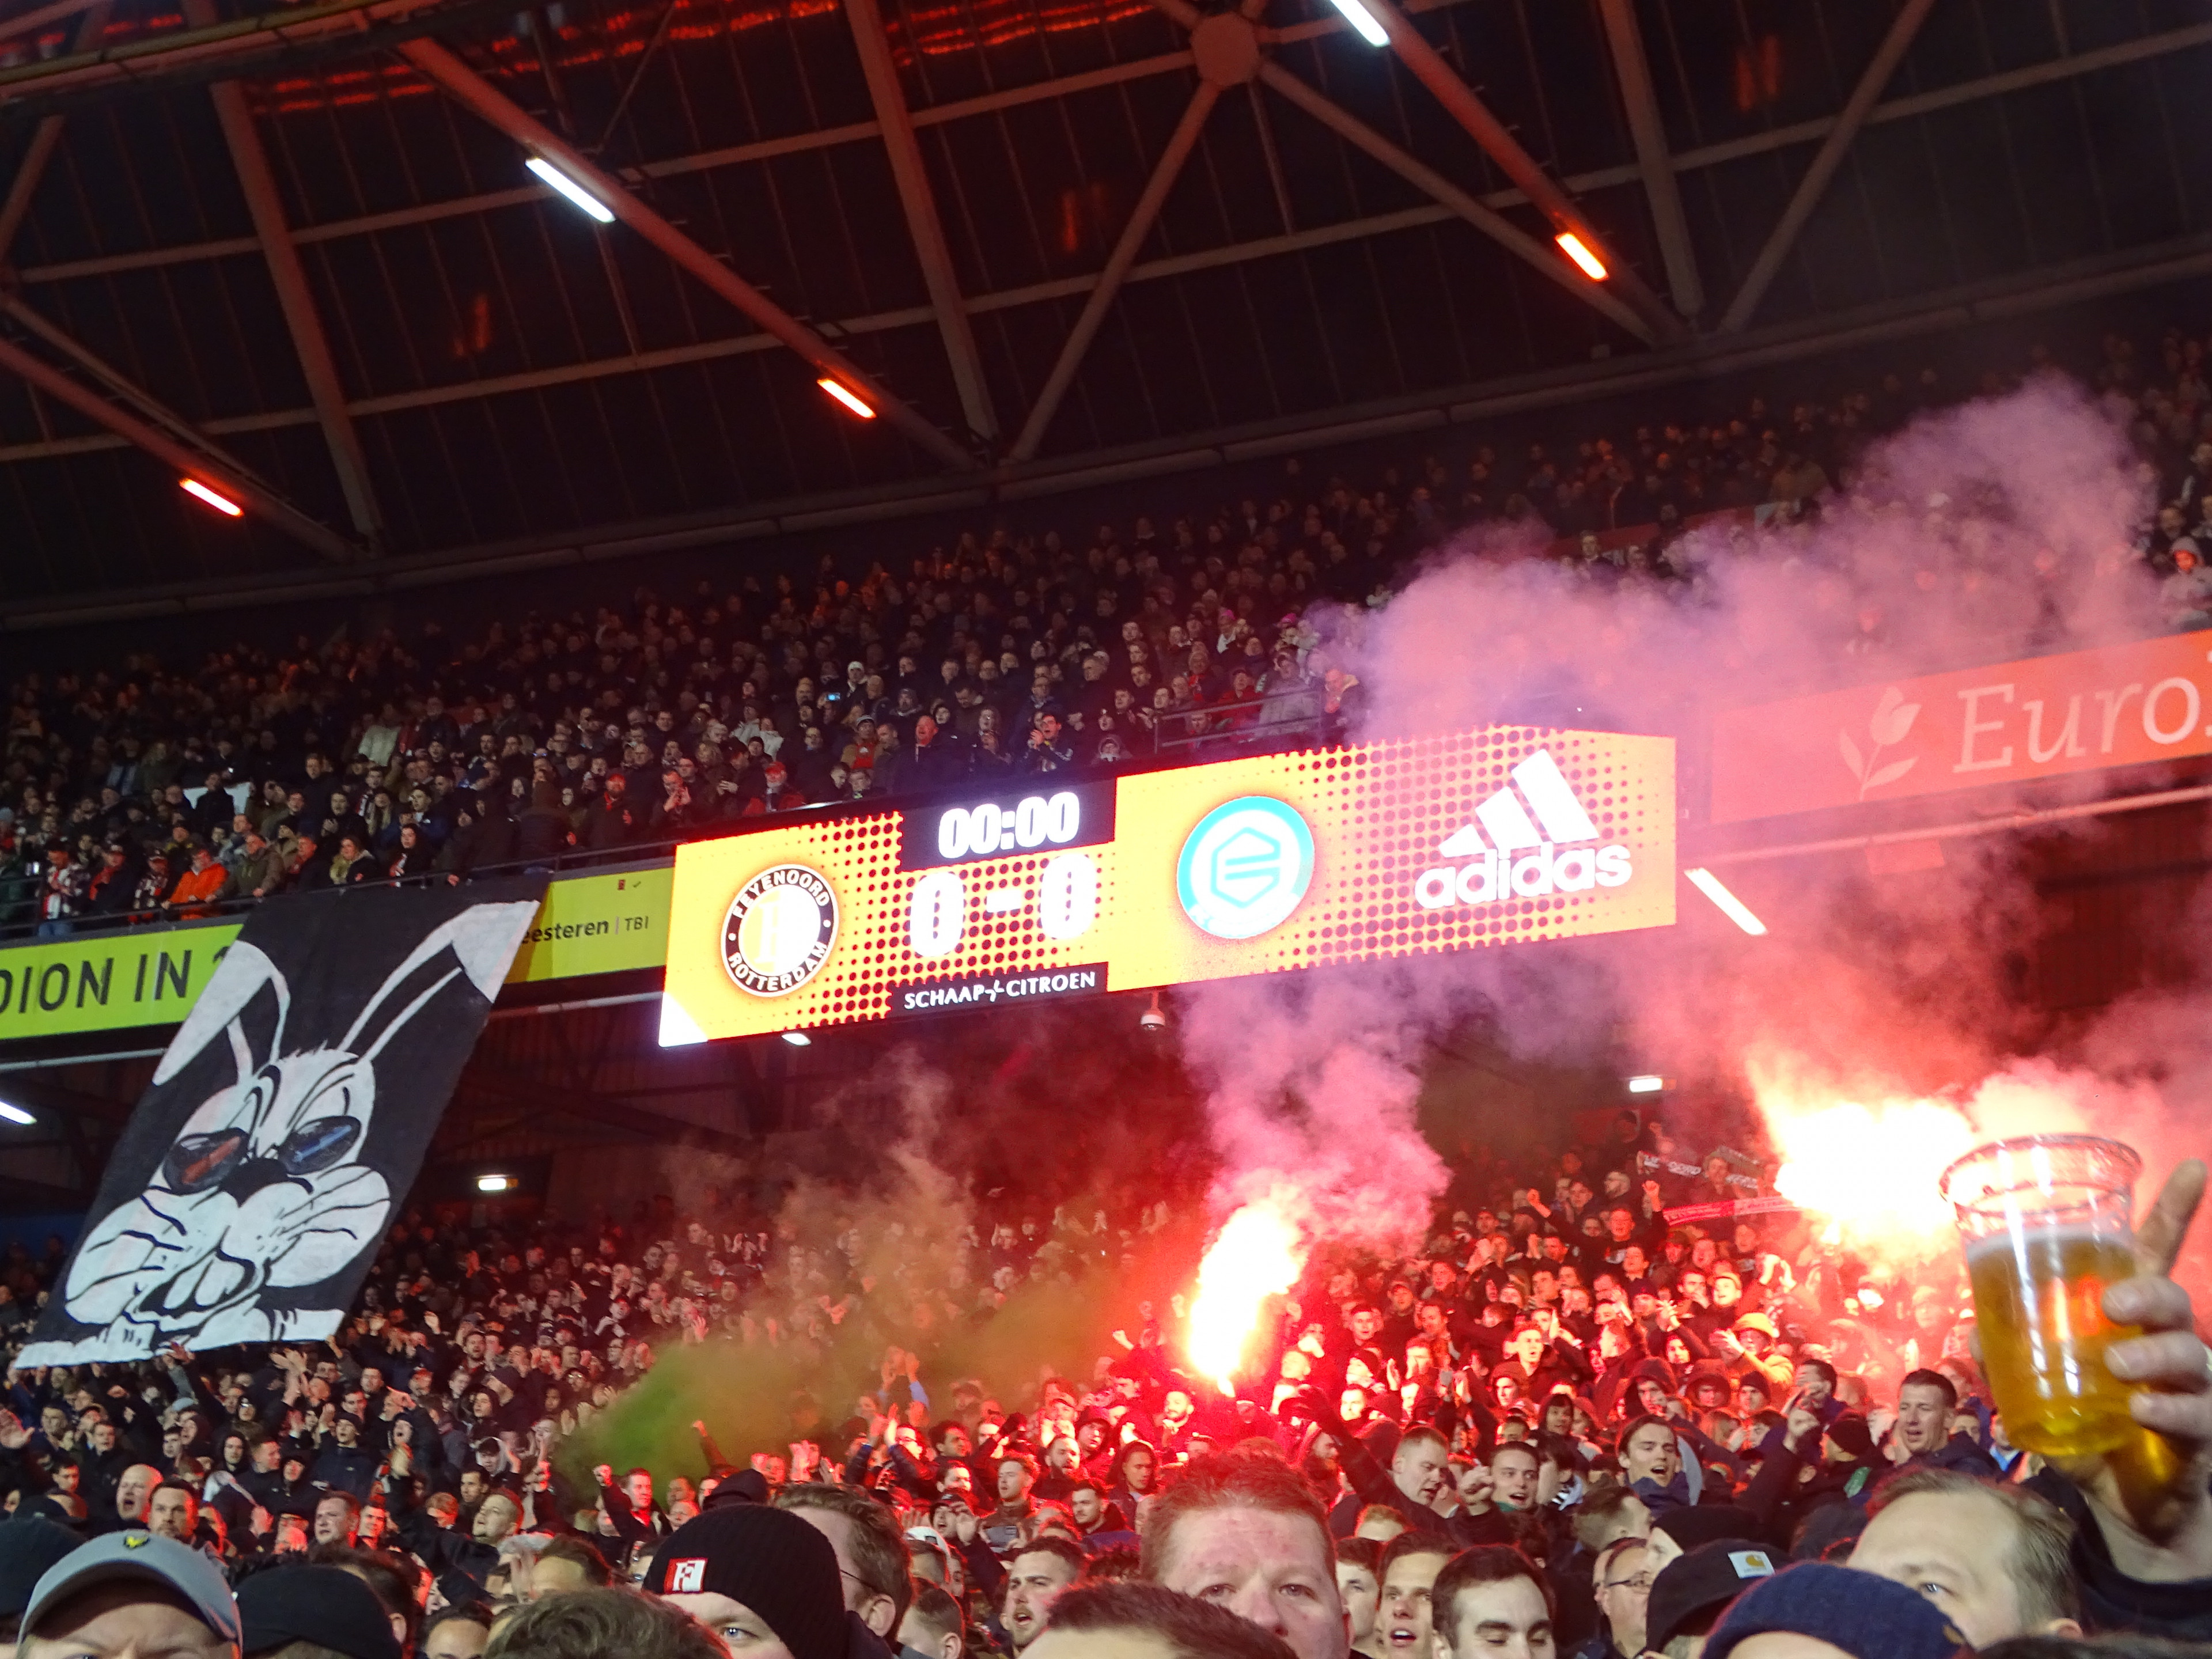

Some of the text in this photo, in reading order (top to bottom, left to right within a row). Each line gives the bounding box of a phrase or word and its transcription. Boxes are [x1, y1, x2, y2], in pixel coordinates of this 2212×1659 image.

[1952, 650, 2212, 773] Euro
[938, 792, 1080, 858] 00:00
[732, 869, 830, 919] FEYENOORD
[1415, 841, 1632, 909] adidas
[624, 916, 649, 931] TBI
[134, 949, 192, 1003] IN
[728, 941, 828, 991] ROTTERDAM
